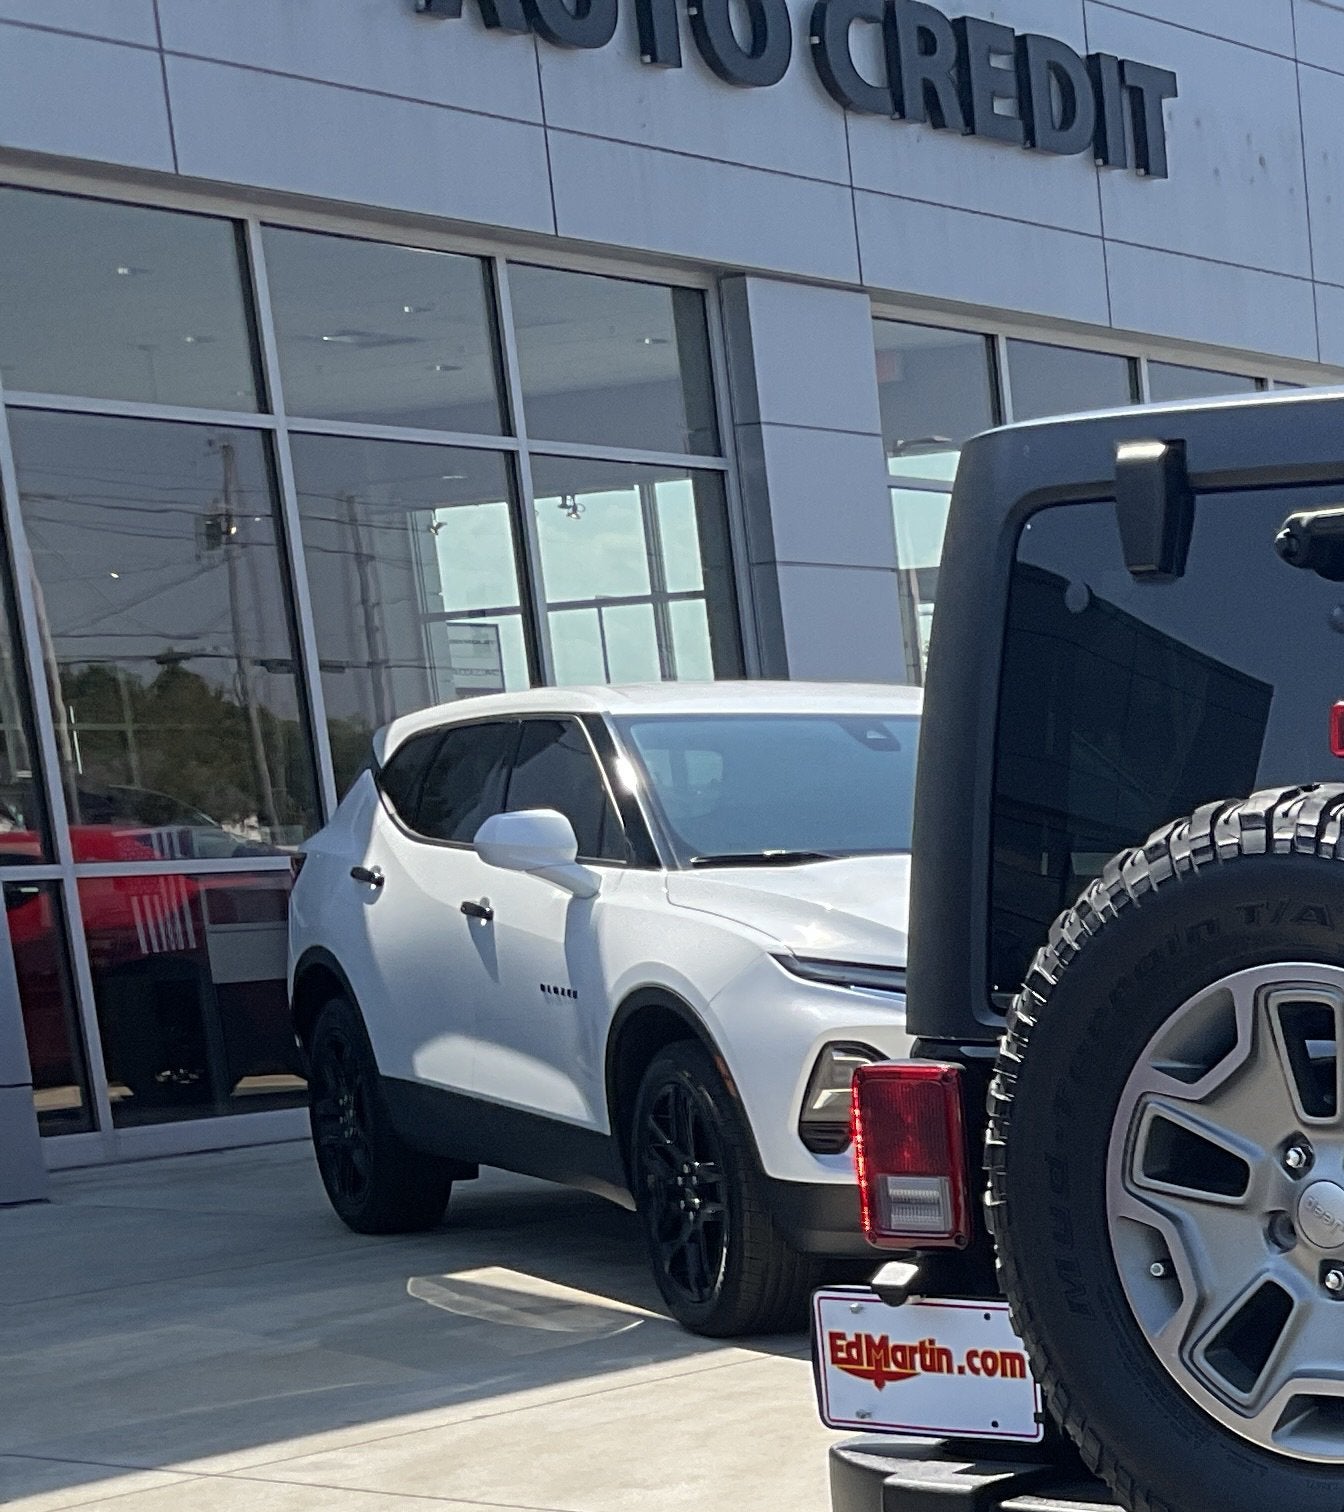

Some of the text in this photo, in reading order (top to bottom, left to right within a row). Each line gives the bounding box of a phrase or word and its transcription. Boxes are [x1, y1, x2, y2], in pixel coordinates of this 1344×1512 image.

[415, 0, 1178, 179] TO CREDIT
[1235, 897, 1335, 930] T/A
[828, 1330, 1027, 1379] EdMartin.com
